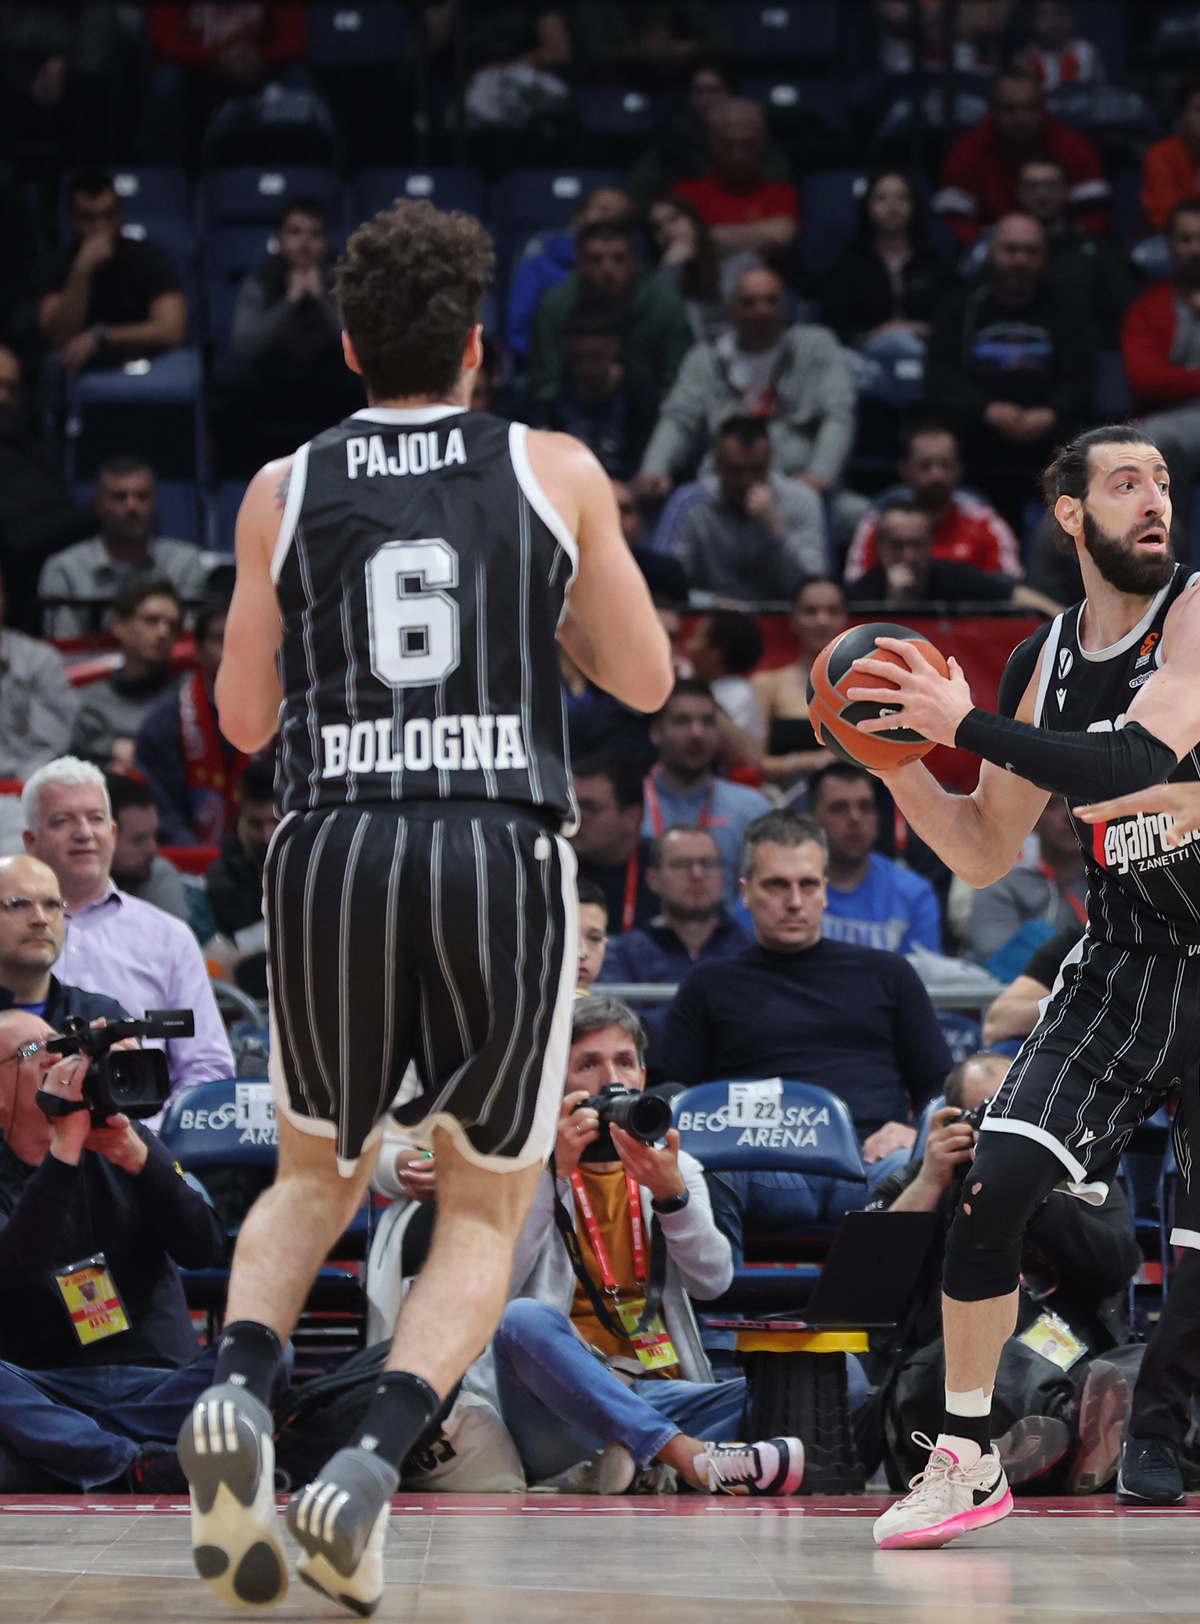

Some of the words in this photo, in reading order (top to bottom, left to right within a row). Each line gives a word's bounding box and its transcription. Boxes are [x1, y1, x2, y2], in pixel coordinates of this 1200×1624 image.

[346, 427, 467, 479] PAJOLA
[365, 537, 461, 689] 6
[321, 714, 528, 779] BOLOGNA
[1137, 848, 1190, 873] ZANETTI
[735, 1102, 743, 1118] 1
[753, 1102, 777, 1120] 22
[736, 1126, 818, 1148] ARENA
